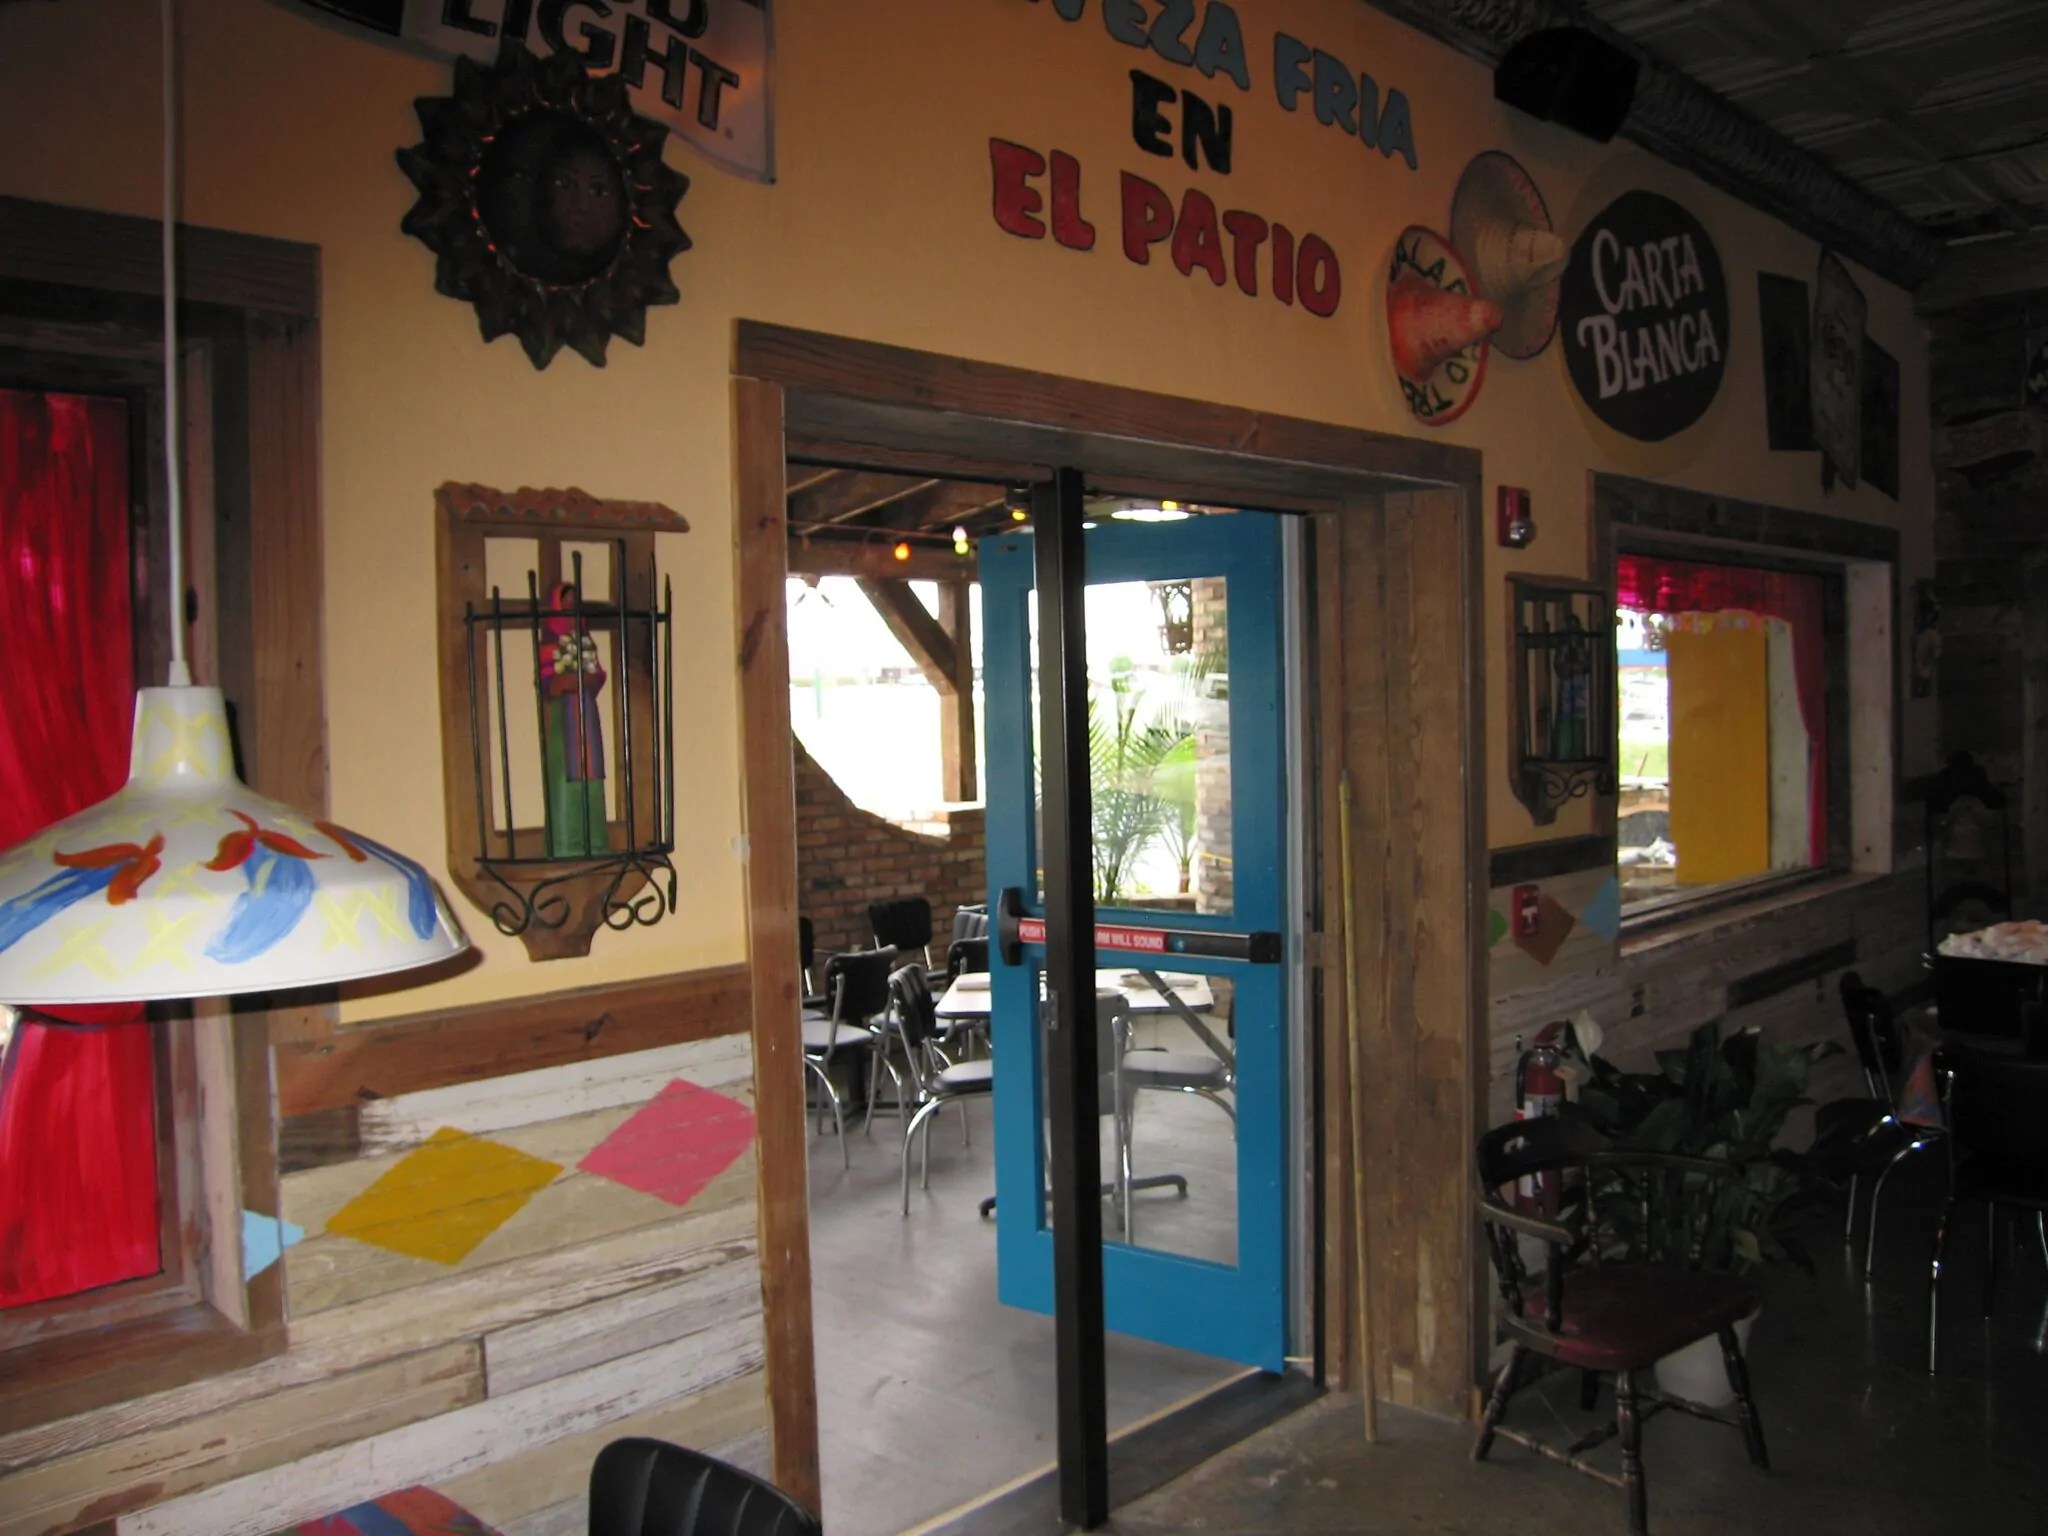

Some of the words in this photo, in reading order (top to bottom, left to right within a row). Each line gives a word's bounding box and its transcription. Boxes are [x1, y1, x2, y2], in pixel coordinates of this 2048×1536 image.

[1129, 69, 1233, 175] EN
[1274, 31, 1417, 170] FRIA
[989, 137, 1096, 251] EL
[1120, 169, 1341, 318] PATIO
[1592, 228, 1705, 315] CARTA
[1576, 308, 1721, 399] BLANCA
[1019, 924, 1041, 938] PUSH
[1111, 933, 1132, 947] WILL
[1133, 934, 1163, 950] SOUND
